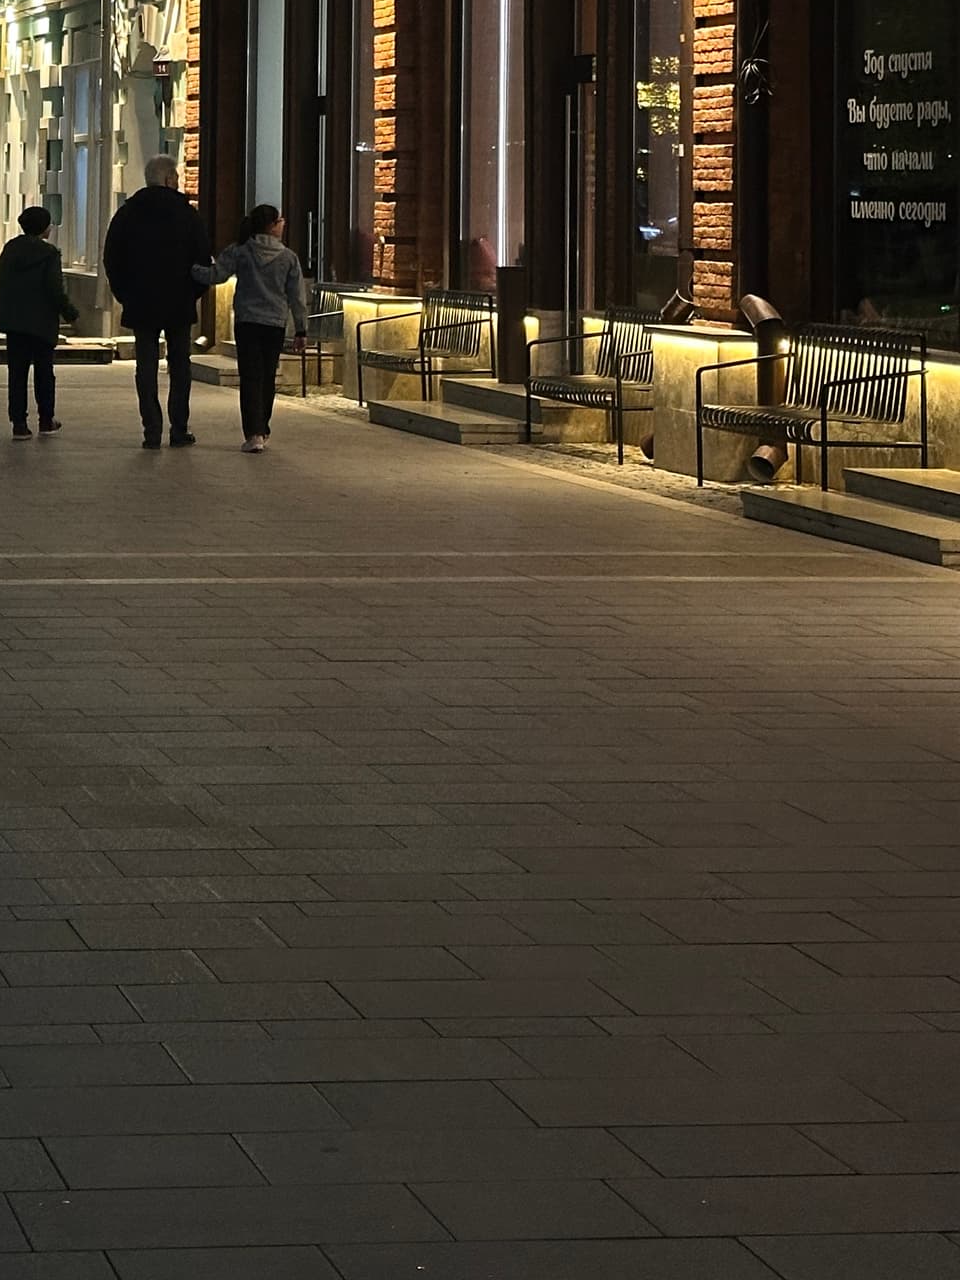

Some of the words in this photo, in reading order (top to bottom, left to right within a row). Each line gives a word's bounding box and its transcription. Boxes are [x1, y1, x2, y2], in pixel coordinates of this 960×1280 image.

[864, 49, 885, 80] Год
[888, 51, 932, 79] спустя
[847, 98, 866, 123] Вы
[869, 95, 913, 129] будете
[917, 100, 952, 128] рады,
[863, 152, 888, 171] что
[892, 150, 934, 171] начали
[851, 201, 895, 221] именно
[899, 201, 946, 228] сегодня
